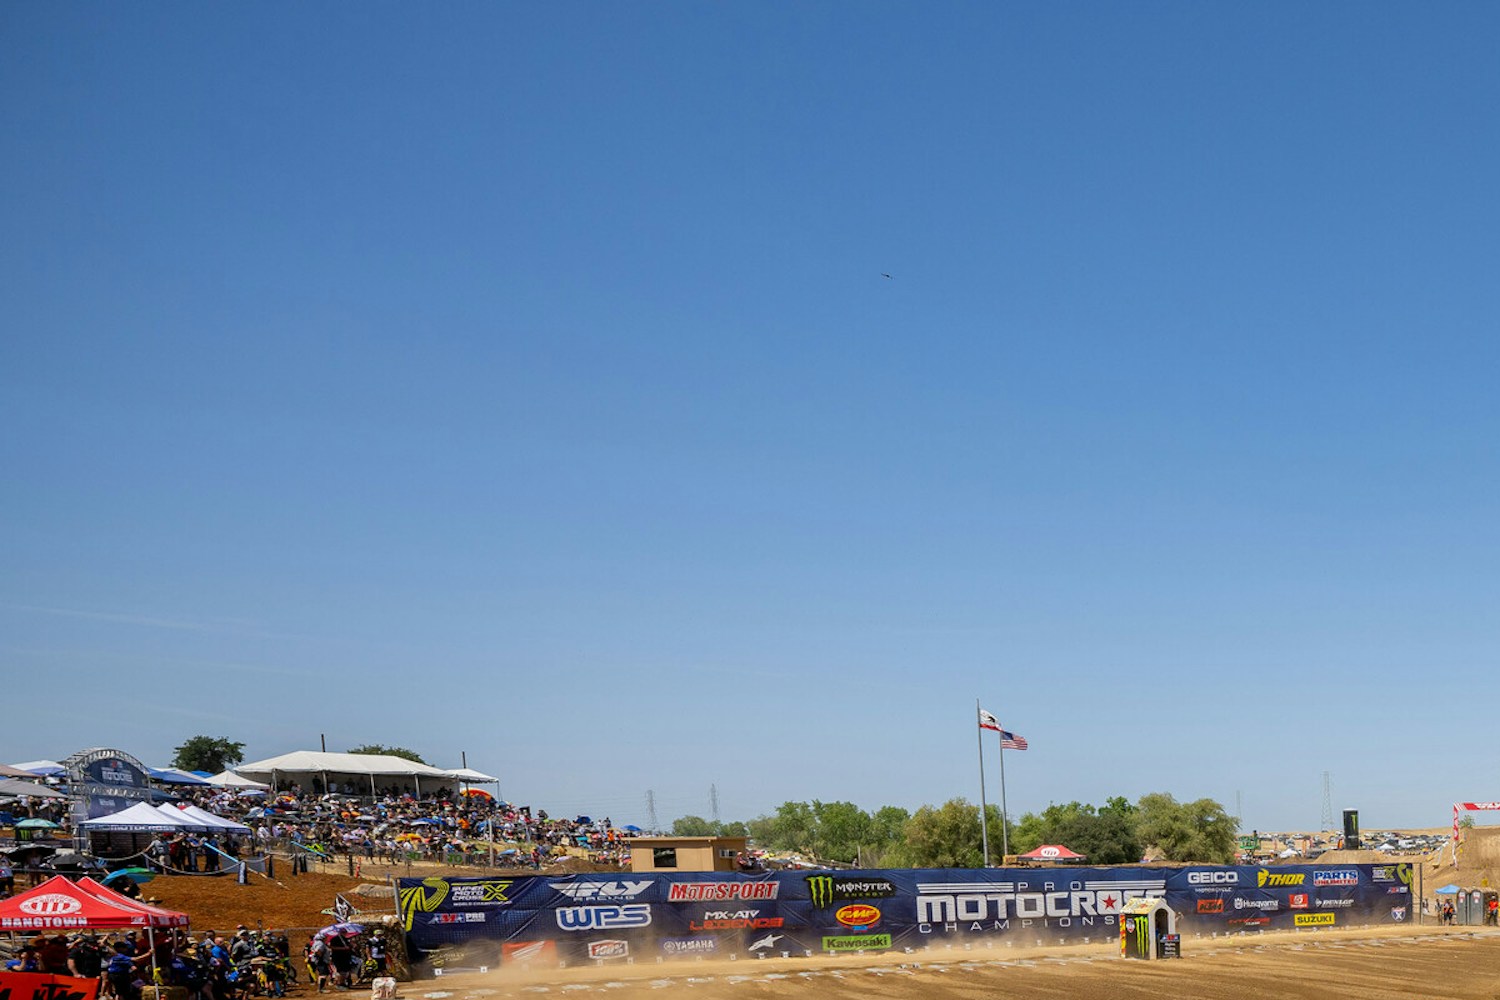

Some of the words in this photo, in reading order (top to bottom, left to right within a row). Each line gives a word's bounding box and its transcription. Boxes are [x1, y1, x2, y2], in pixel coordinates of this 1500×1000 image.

[1188, 872, 1239, 884] GEICO
[1268, 874, 1305, 886] THOR
[1314, 871, 1357, 880] PARTS
[548, 881, 655, 897] FLY
[836, 882, 892, 893] MONSTER
[1018, 881, 1083, 892] PRO
[1244, 899, 1279, 909] Husqvarna
[557, 904, 652, 930] WPS
[705, 910, 760, 920] MX-ATV
[840, 909, 877, 919] FMF
[1297, 915, 1333, 923] SUZUKI
[1, 917, 88, 928] HANGTOWN
[689, 918, 784, 931] LEGENDS
[919, 917, 1115, 934] CHAMPIONS
[675, 940, 714, 950] YAMAHA
[827, 936, 887, 948] Kawasaki
